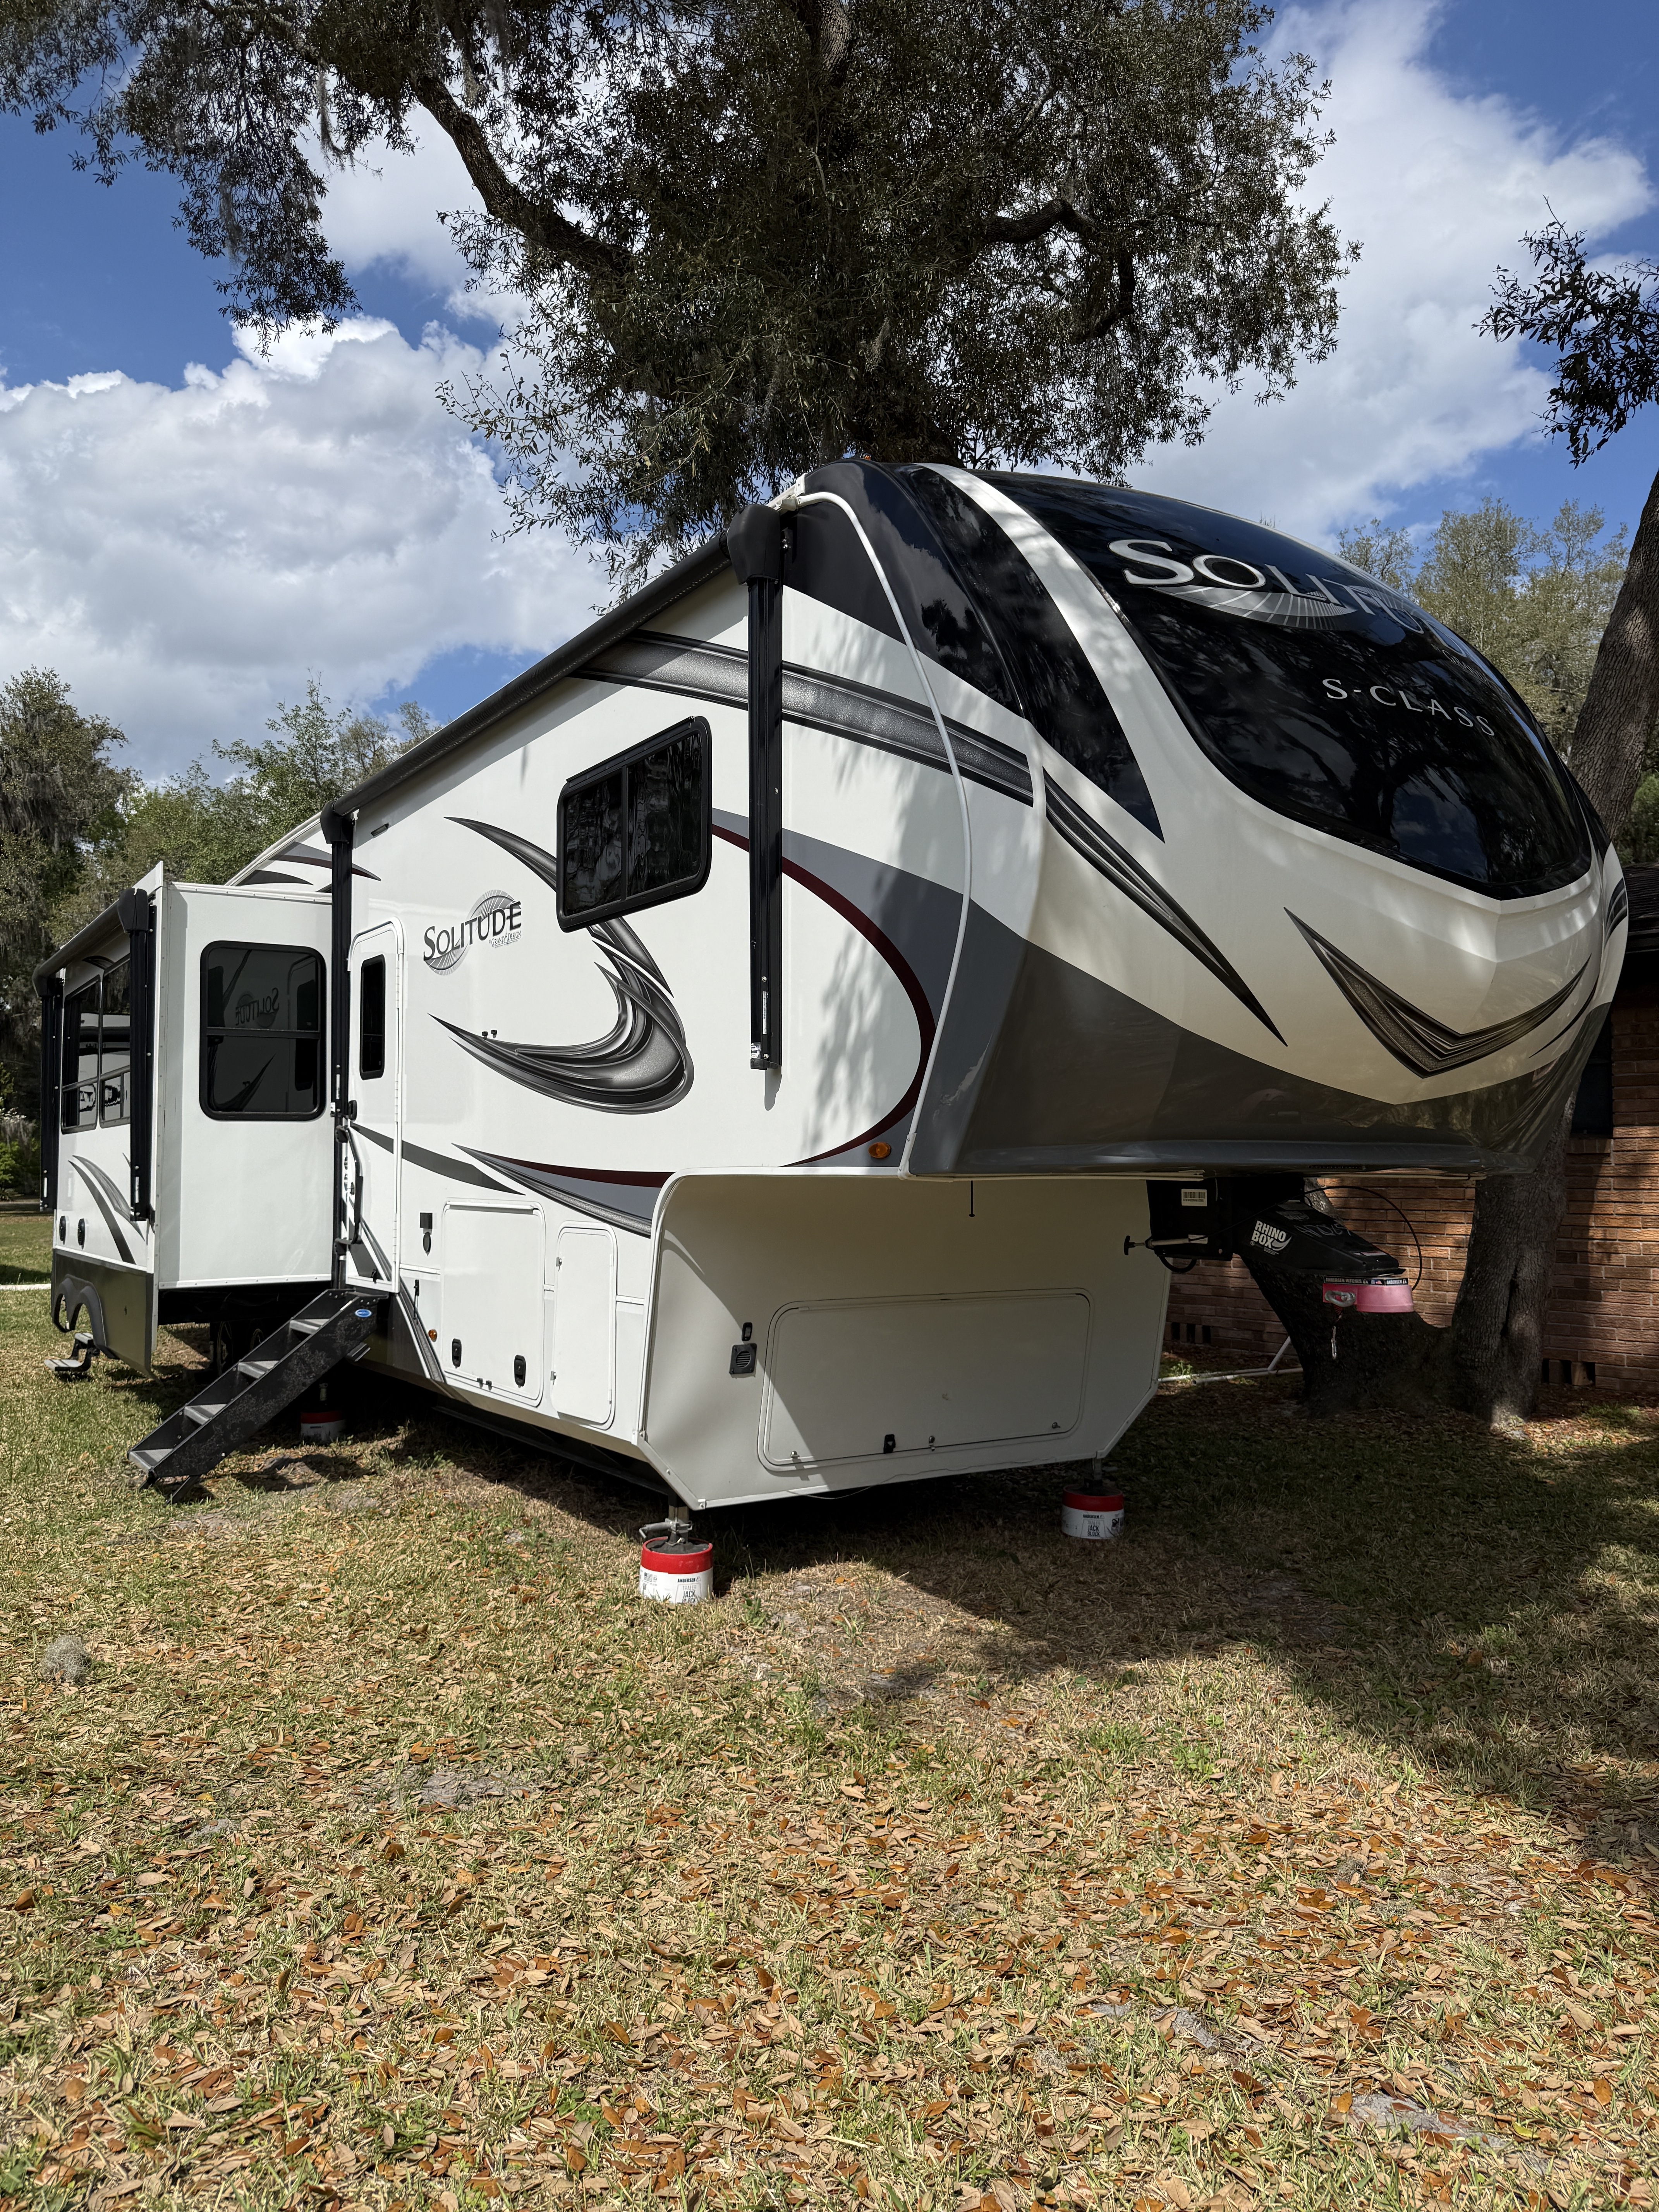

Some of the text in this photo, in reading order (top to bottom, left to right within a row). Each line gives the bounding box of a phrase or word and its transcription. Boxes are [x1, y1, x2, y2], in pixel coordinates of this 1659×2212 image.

[1322, 678, 1495, 737] S-CLASS
[423, 901, 521, 961] SOLITUDE
[1251, 1230, 1274, 1249] BOX
[1254, 1220, 1286, 1242] RHINO
